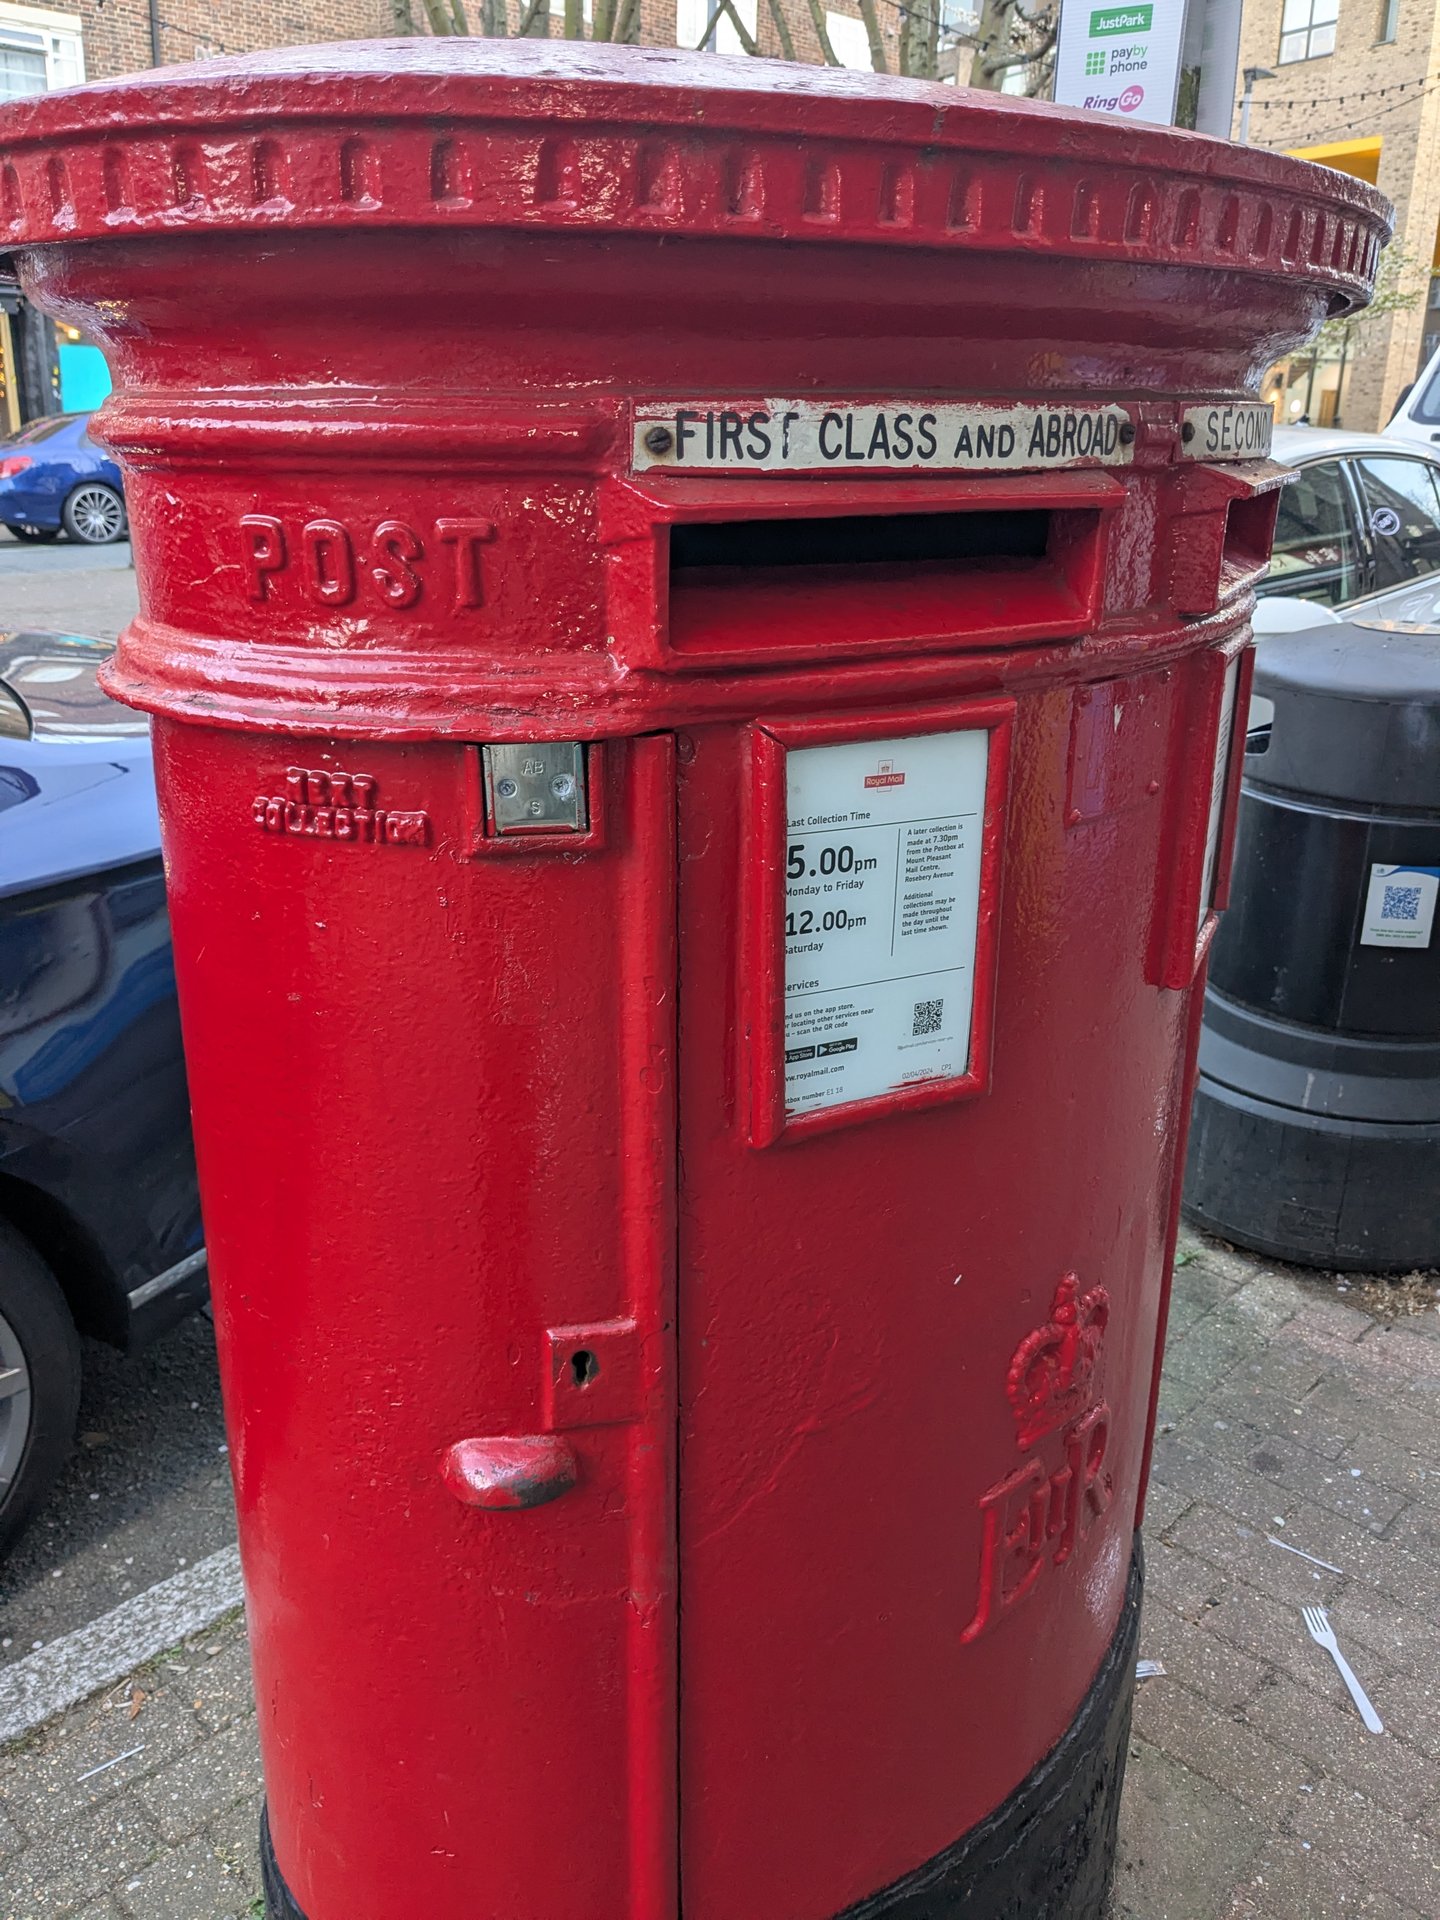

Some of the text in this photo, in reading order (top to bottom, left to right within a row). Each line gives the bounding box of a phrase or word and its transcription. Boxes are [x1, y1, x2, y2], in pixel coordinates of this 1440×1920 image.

[1096, 13, 1145, 30] JustPark
[1111, 45, 1148, 61] payby
[1110, 60, 1148, 76] phone
[675, 411, 1118, 460] FIRST CLASS AND ABROAD
[1206, 407, 1267, 451] SECOND
[239, 513, 498, 610] POST
[866, 775, 903, 786] Royal Mail
[787, 811, 871, 828] Last Collection Time
[929, 824, 957, 834] collection
[907, 838, 924, 846] made
[933, 834, 959, 843] 7.30pm
[934, 844, 957, 852] Postbox
[787, 844, 877, 879] 5.00pm
[906, 853, 952, 864] Mount Pleasant
[905, 871, 954, 883] Rosebery Avenue
[823, 884, 832, 892] to
[836, 880, 864, 895] Friday
[903, 890, 933, 900] Additional
[903, 900, 933, 910] collections
[920, 906, 952, 915] throughout
[786, 909, 867, 937] 12.00pm
[925, 915, 939, 923] until
[825, 1006, 837, 1014] app
[837, 1003, 855, 1011] store.
[791, 1019, 816, 1028] locating
[817, 1015, 834, 1023] other
[835, 1011, 859, 1020] services
[796, 1028, 811, 1036] scan
[823, 1023, 833, 1031] QR
[834, 1021, 848, 1029] code
[801, 1091, 826, 1101] number
